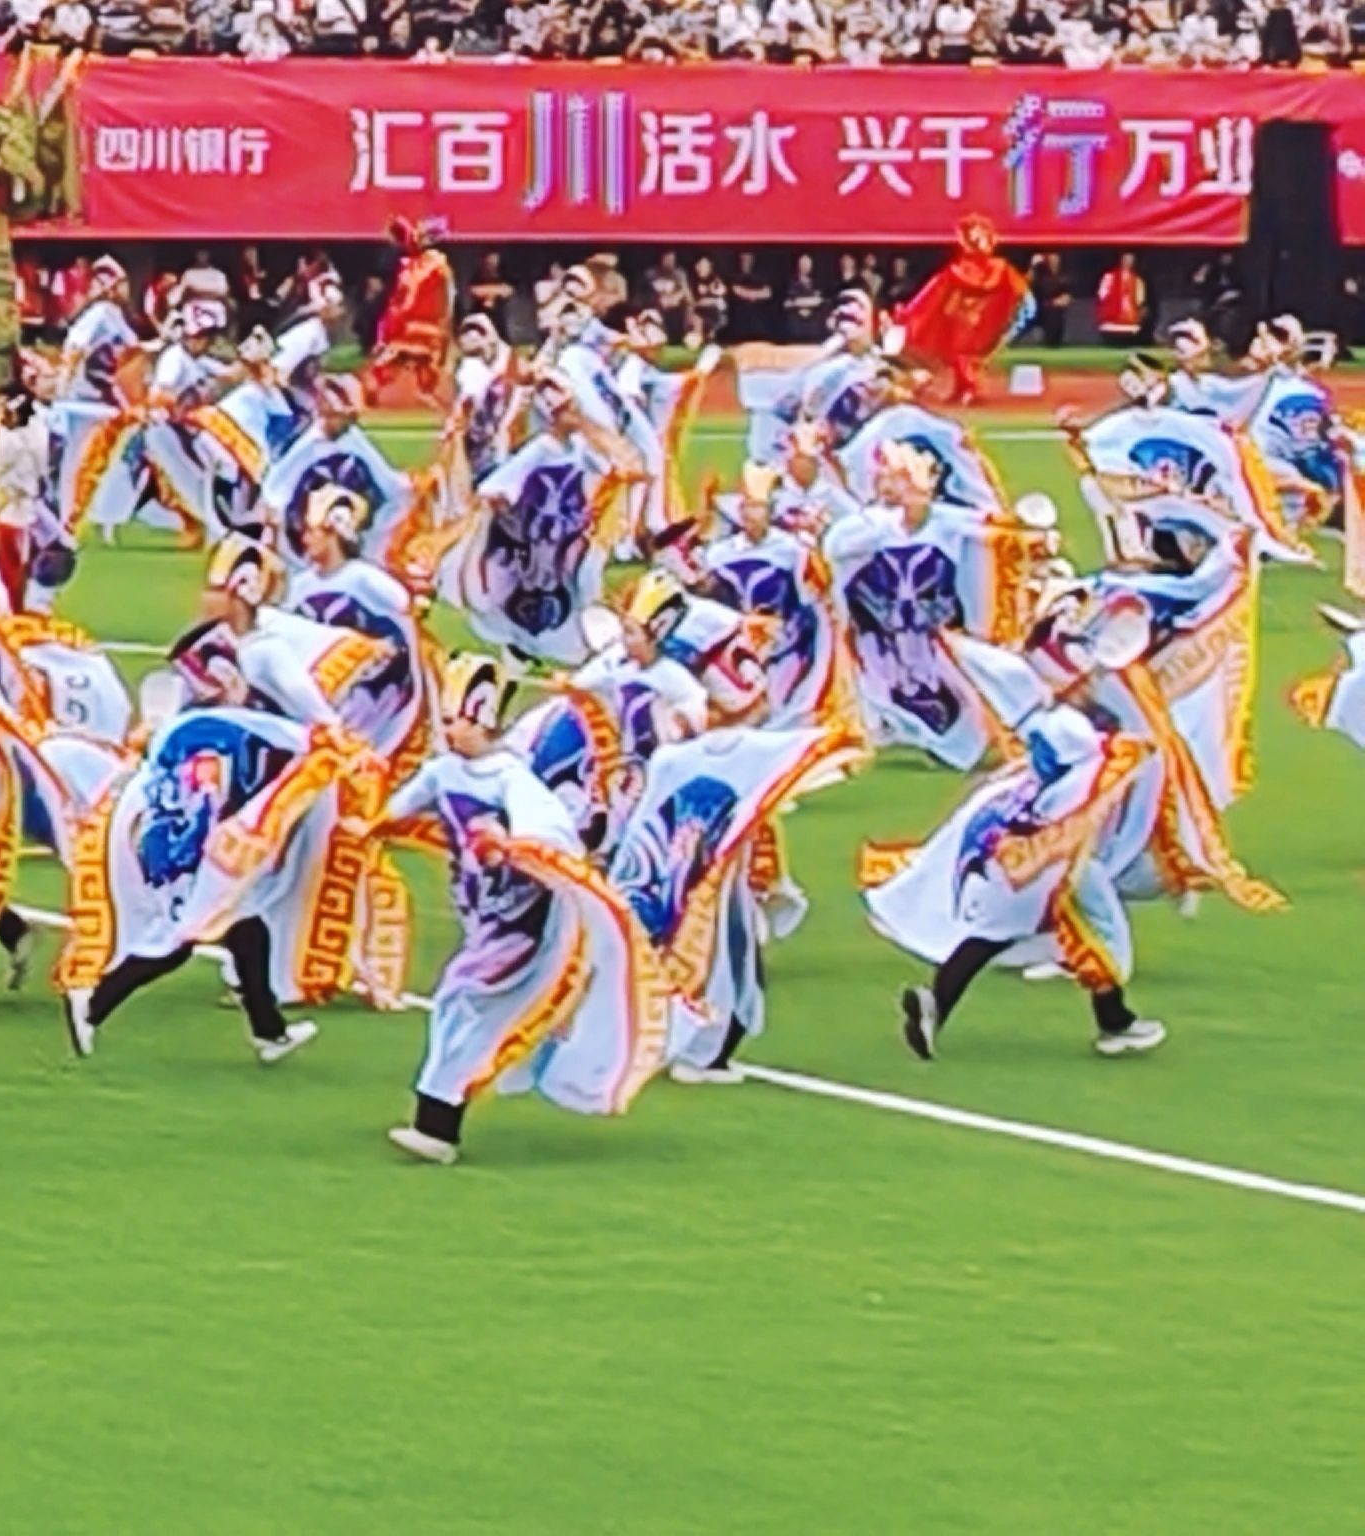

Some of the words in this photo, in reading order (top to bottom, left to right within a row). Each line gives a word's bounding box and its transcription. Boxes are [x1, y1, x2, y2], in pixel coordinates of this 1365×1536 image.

[97, 126, 271, 175] 四川银行
[349, 90, 799, 216] 汇百川活水
